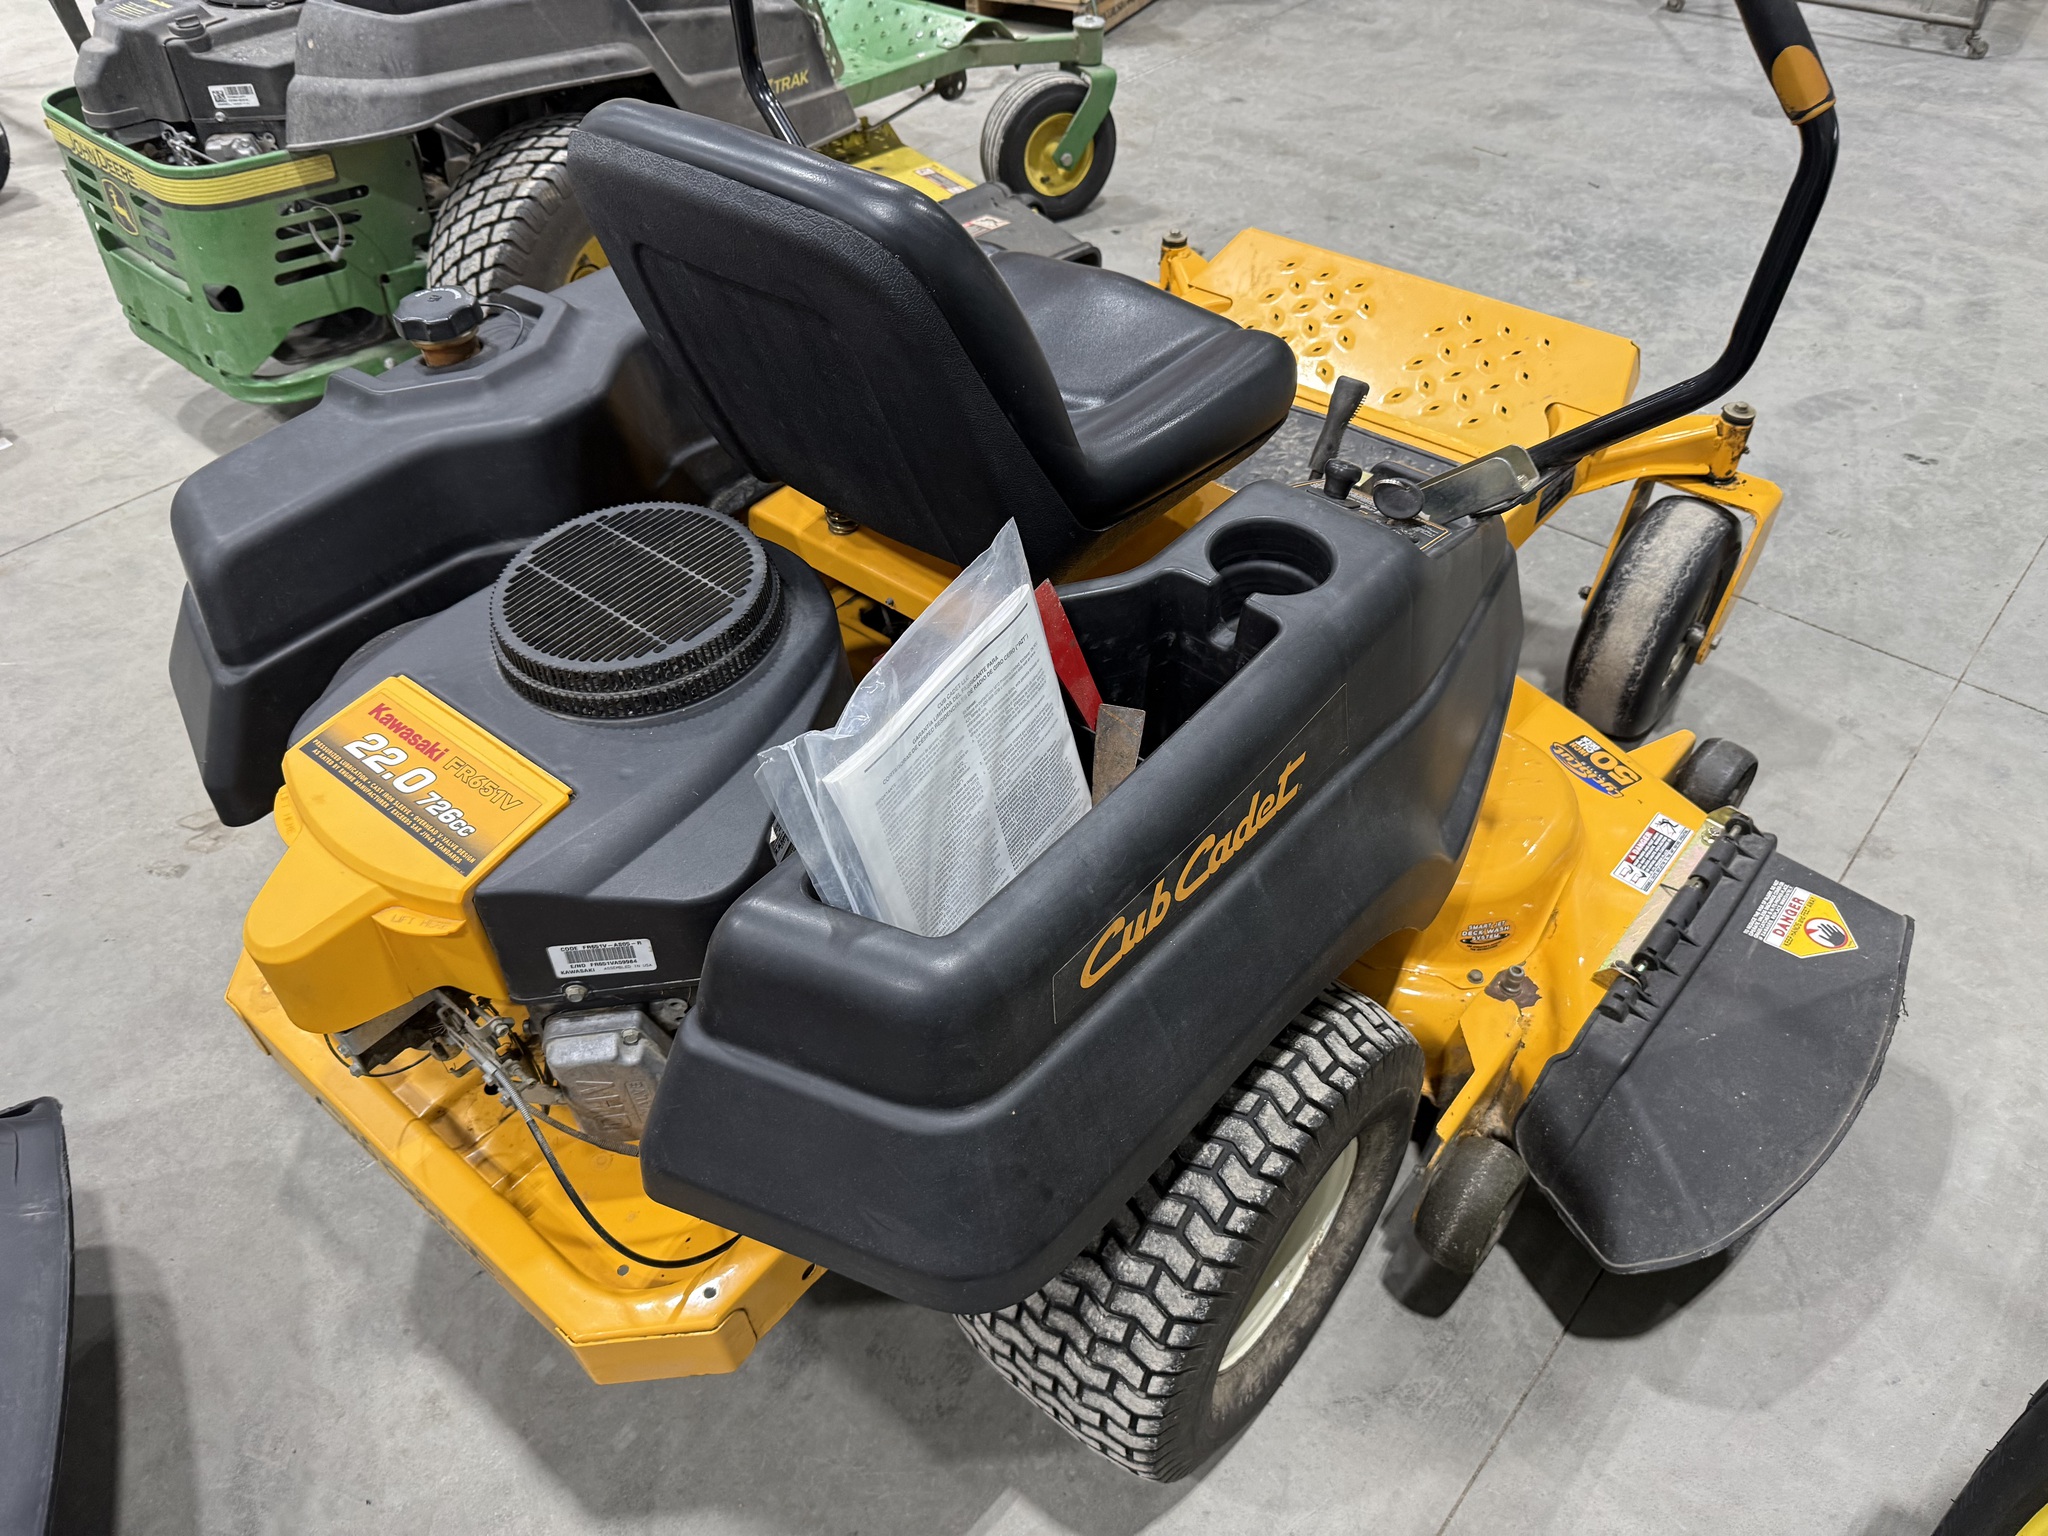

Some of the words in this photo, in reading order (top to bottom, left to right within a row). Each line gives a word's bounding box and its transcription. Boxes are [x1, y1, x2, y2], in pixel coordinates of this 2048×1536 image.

[95, 148, 140, 189] DEERE
[986, 669, 993, 678] DE
[993, 659, 1004, 671] GIRO
[1003, 648, 1015, 661] CERO
[987, 656, 999, 669] PARA
[947, 682, 961, 699] CADET
[368, 703, 449, 762] Kawasaki
[443, 756, 522, 811] FR651V
[1568, 740, 1590, 758] INCH
[1574, 738, 1595, 754] CUT
[343, 732, 437, 794] 22.0
[415, 792, 476, 837] 726cc
[1590, 751, 1639, 786] 50
[311, 738, 341, 762] PRESSURIZED
[338, 758, 369, 783] LUBRICATION
[369, 782, 384, 795] CAST
[381, 791, 395, 803] IRON
[393, 800, 411, 815] SLEEVE
[413, 815, 439, 836] OVERHEAD
[456, 848, 476, 865] DESIGN
[311, 747, 321, 757] AS
[319, 753, 335, 767] RATED
[337, 768, 356, 784] ENGINE
[352, 780, 390, 810] MANUFACTURER
[390, 808, 412, 827] EXCEEDS
[410, 823, 422, 834] SAE
[433, 841, 463, 865] STANDARDS
[1631, 830, 1653, 855] DANGER
[1080, 877, 1171, 989] Cub
[1174, 751, 1306, 902] Cadet
[1468, 922, 1492, 930] SMART
[1486, 925, 1510, 934] WASH
[1772, 897, 1805, 937] DANGER
[1783, 934, 1794, 947] KEEP
[1789, 921, 1801, 936] HANDS
[1801, 906, 1811, 918] FEET
[1472, 933, 1500, 941] SYSTEM
